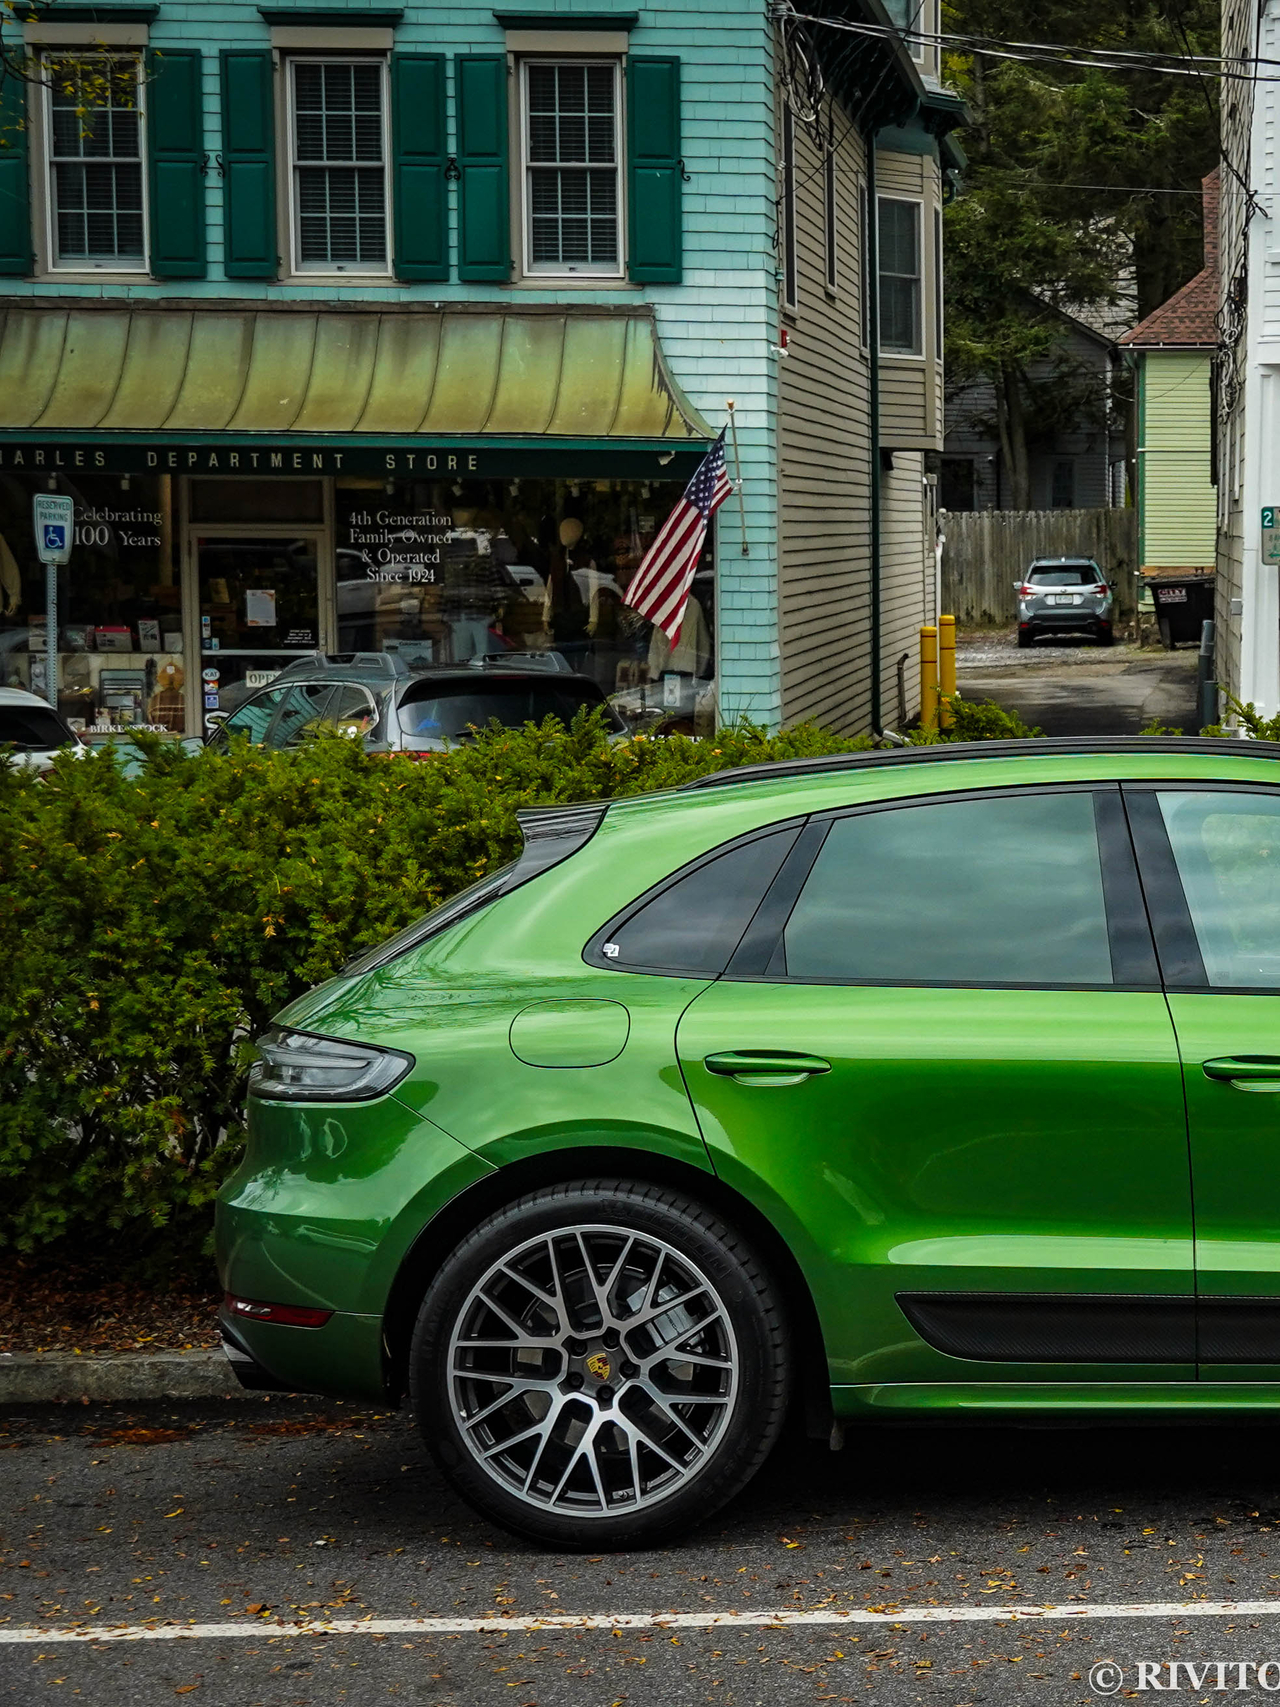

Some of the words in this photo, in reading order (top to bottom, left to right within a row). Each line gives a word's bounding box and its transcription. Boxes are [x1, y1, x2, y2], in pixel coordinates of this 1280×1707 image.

[147, 451, 344, 469] DEPARTMENT
[386, 454, 478, 470] STORE
[38, 500, 70, 511] RESERVED
[40, 511, 69, 522] PARKING
[73, 507, 163, 526] Celebrating
[349, 510, 371, 525] 4th
[376, 510, 452, 526] Generation
[1263, 511, 1273, 526] 2
[74, 525, 109, 545] 100
[119, 531, 161, 546] Years
[350, 528, 395, 547] Family
[402, 528, 452, 544] Owned
[362, 548, 373, 563] &
[378, 548, 440, 566] Operated
[367, 567, 403, 582] Since
[408, 569, 436, 582] 1924
[90, 724, 168, 733] BIRKESTOCK
